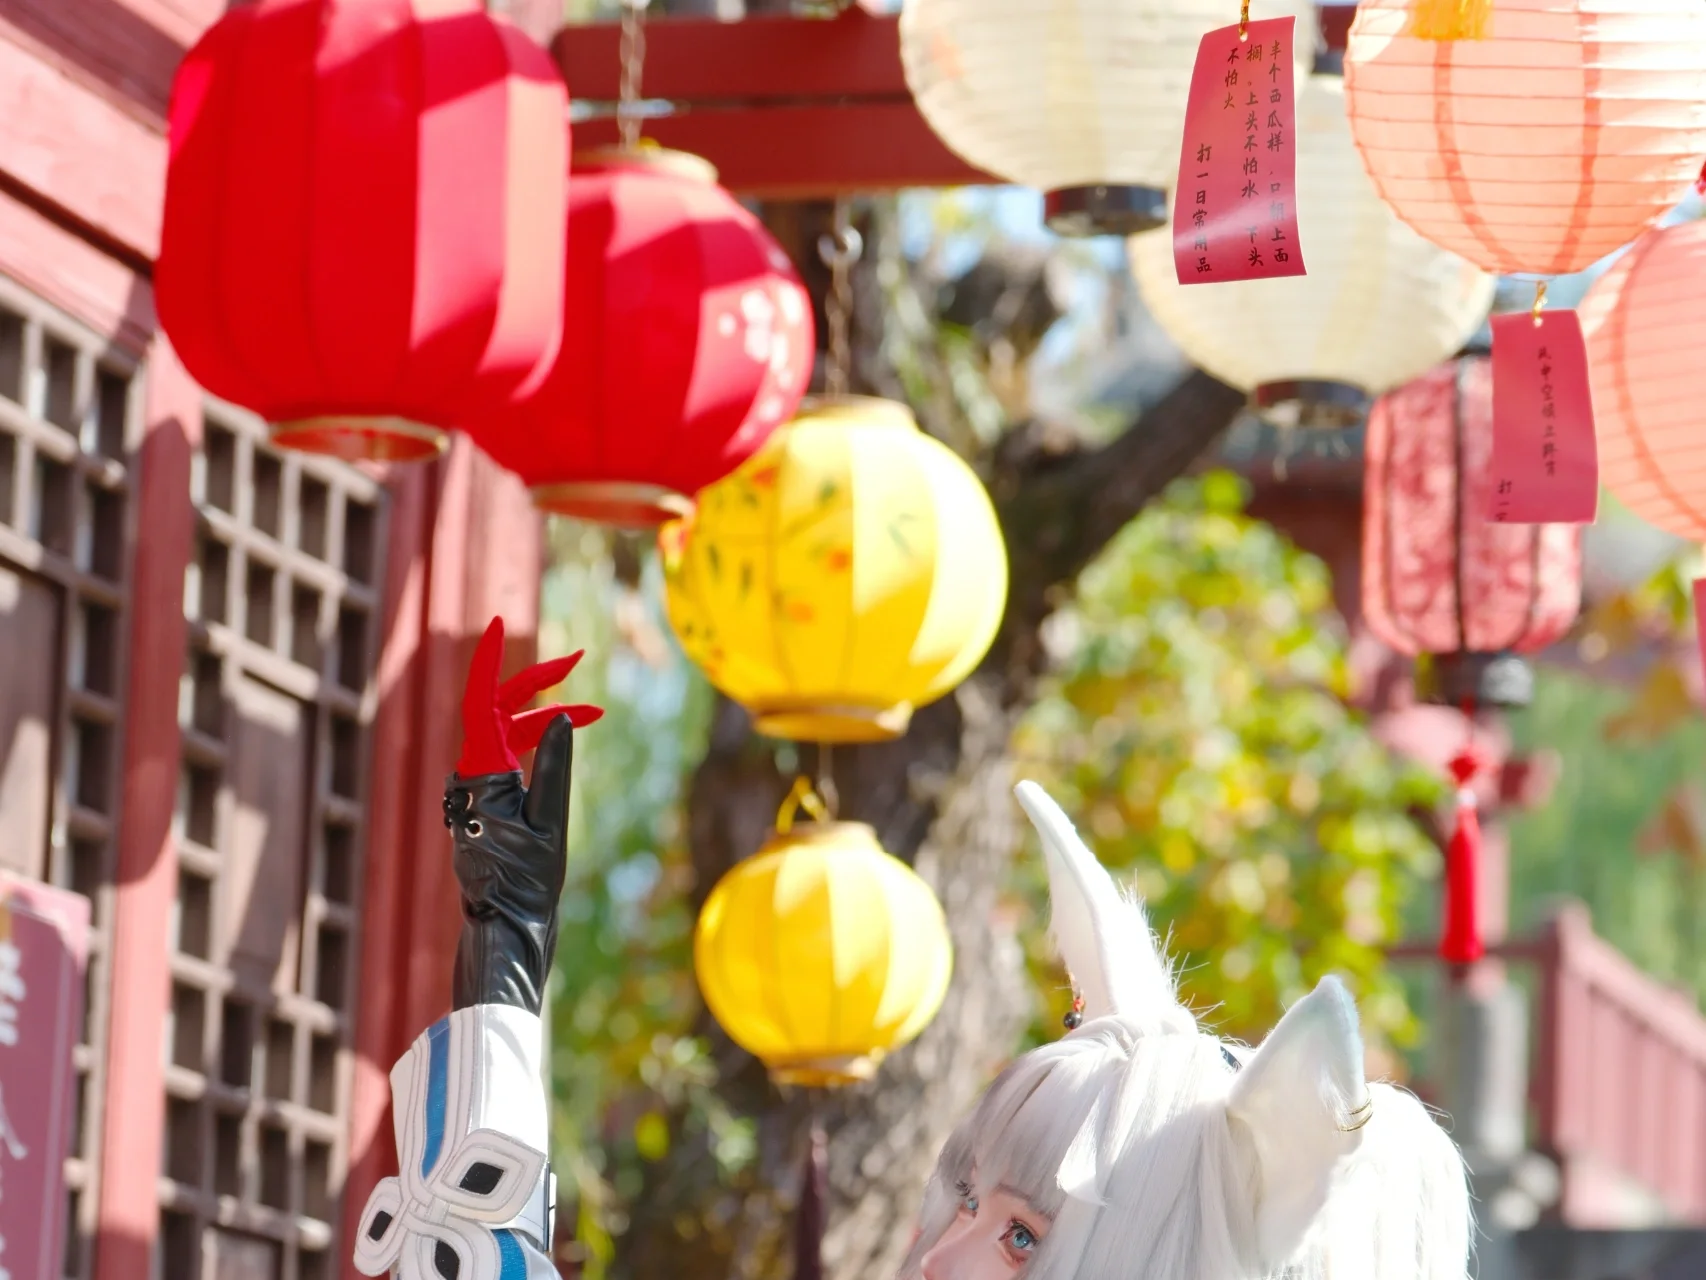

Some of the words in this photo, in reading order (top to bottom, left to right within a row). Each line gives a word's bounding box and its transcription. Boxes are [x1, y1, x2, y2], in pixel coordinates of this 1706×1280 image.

[1222, 47, 1240, 110] 不怕火
[1191, 142, 1213, 273] 打一日常用品
